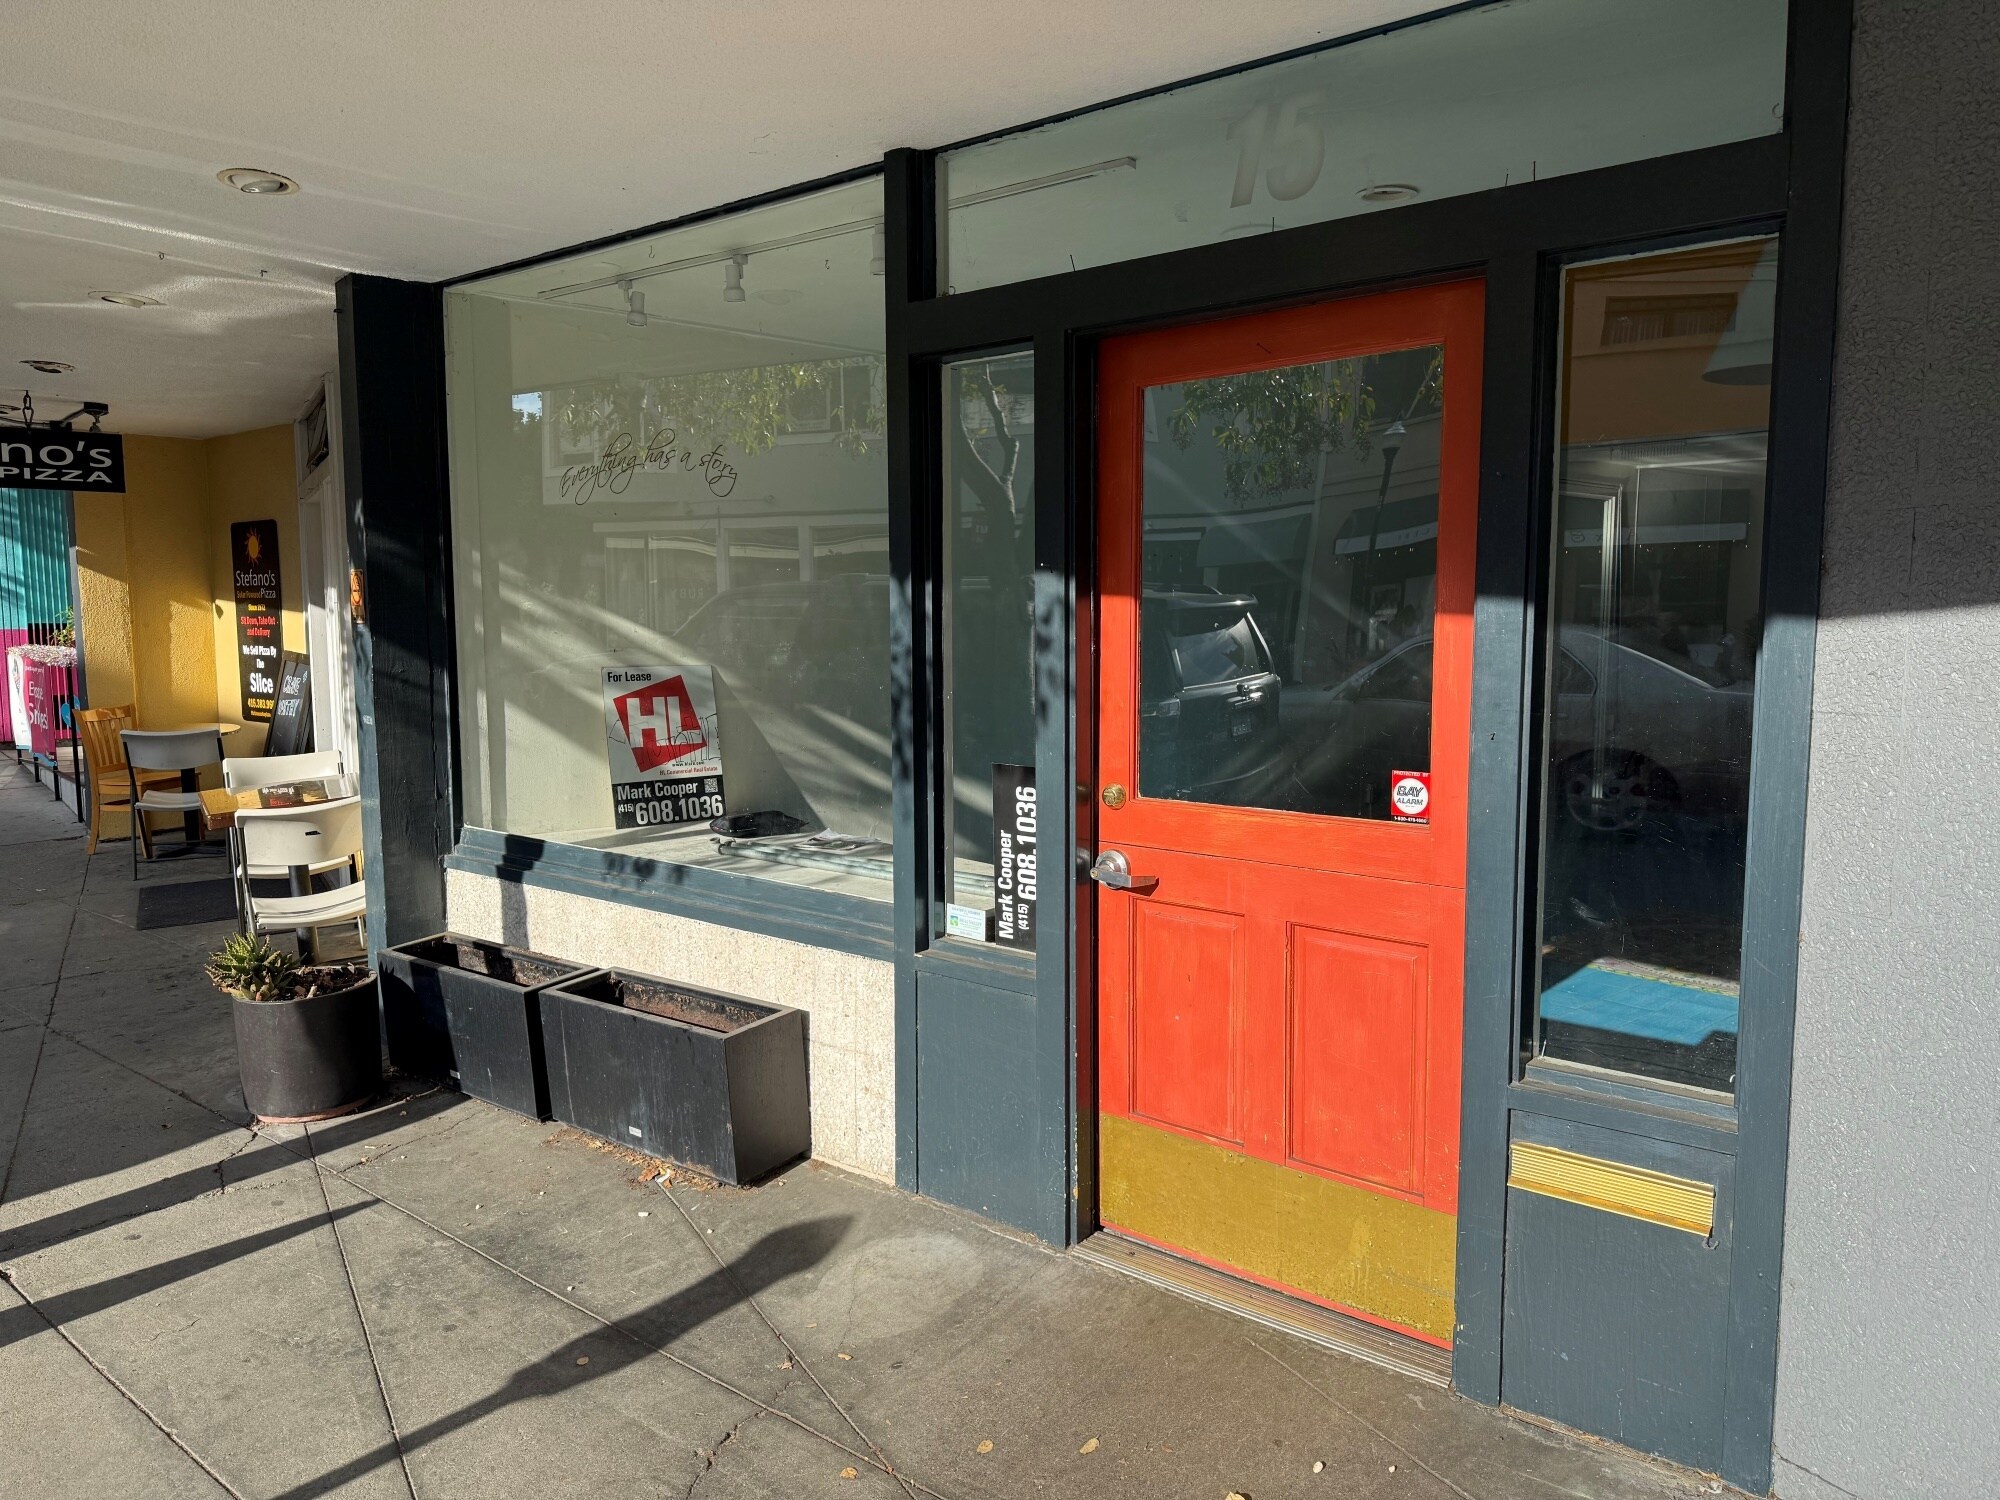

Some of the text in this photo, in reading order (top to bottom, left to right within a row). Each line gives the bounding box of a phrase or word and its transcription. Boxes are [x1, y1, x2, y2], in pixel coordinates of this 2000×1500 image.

[1225, 90, 1328, 208] 15
[1, 440, 113, 468] no's
[0, 466, 113, 484] PIZZA
[559, 427, 738, 506] Everything has a story
[235, 568, 276, 586] Stefano's
[260, 587, 276, 599] Pizza
[242, 644, 277, 658] We Sell Pizza By
[256, 658, 265, 669] The
[249, 672, 274, 694] Slice
[607, 671, 652, 682] For Lease
[626, 696, 703, 748] HL
[617, 782, 699, 801] Mark Cooper
[1396, 785, 1424, 797] BAY
[617, 794, 724, 825] (415) 608.1036
[1396, 797, 1424, 806] ALARM
[1016, 786, 1036, 931] (415) 608.1036
[998, 829, 1016, 940] Mark Cooper
